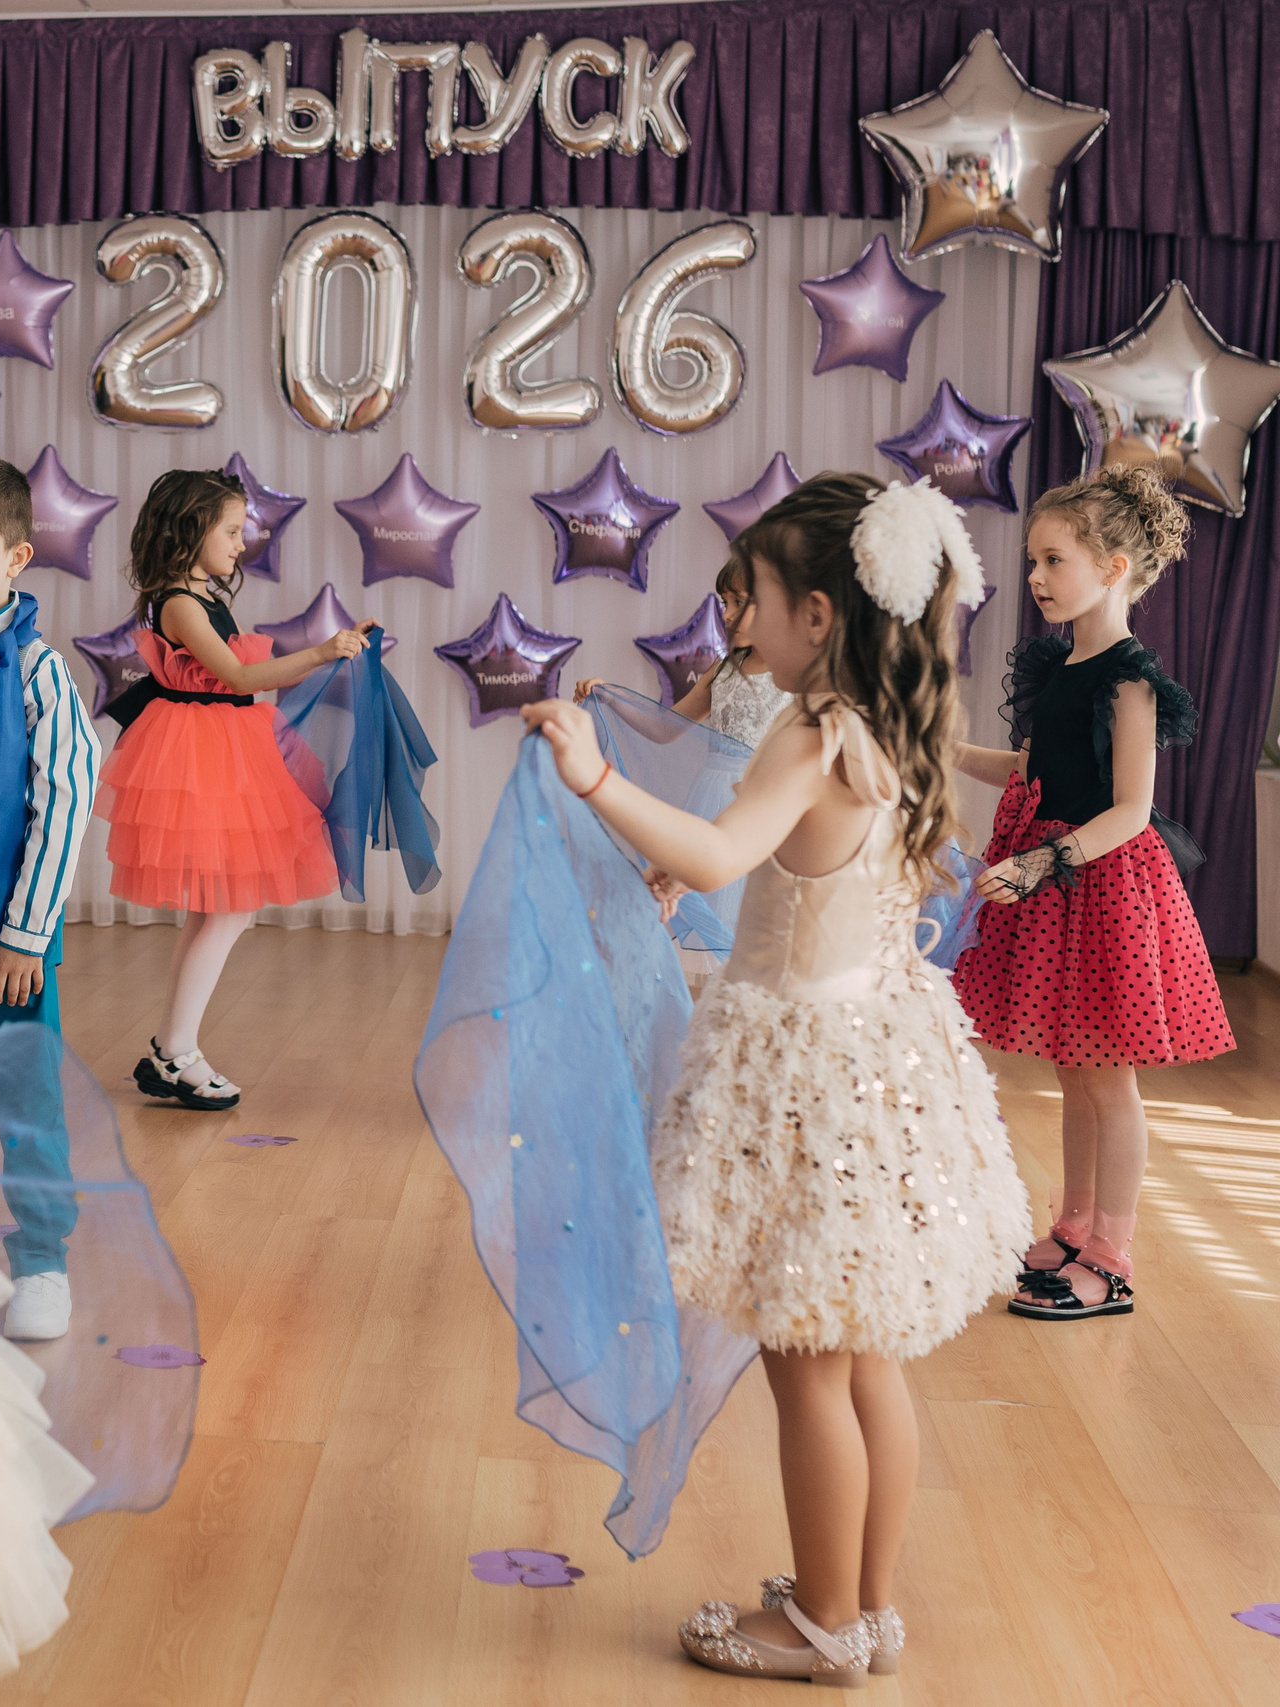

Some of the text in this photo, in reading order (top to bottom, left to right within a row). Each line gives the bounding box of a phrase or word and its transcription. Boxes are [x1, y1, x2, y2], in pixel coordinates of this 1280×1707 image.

[194, 28, 697, 172] ВЫПУСК
[88, 209, 757, 437] 2026
[476, 671, 538, 687] Тимофей
